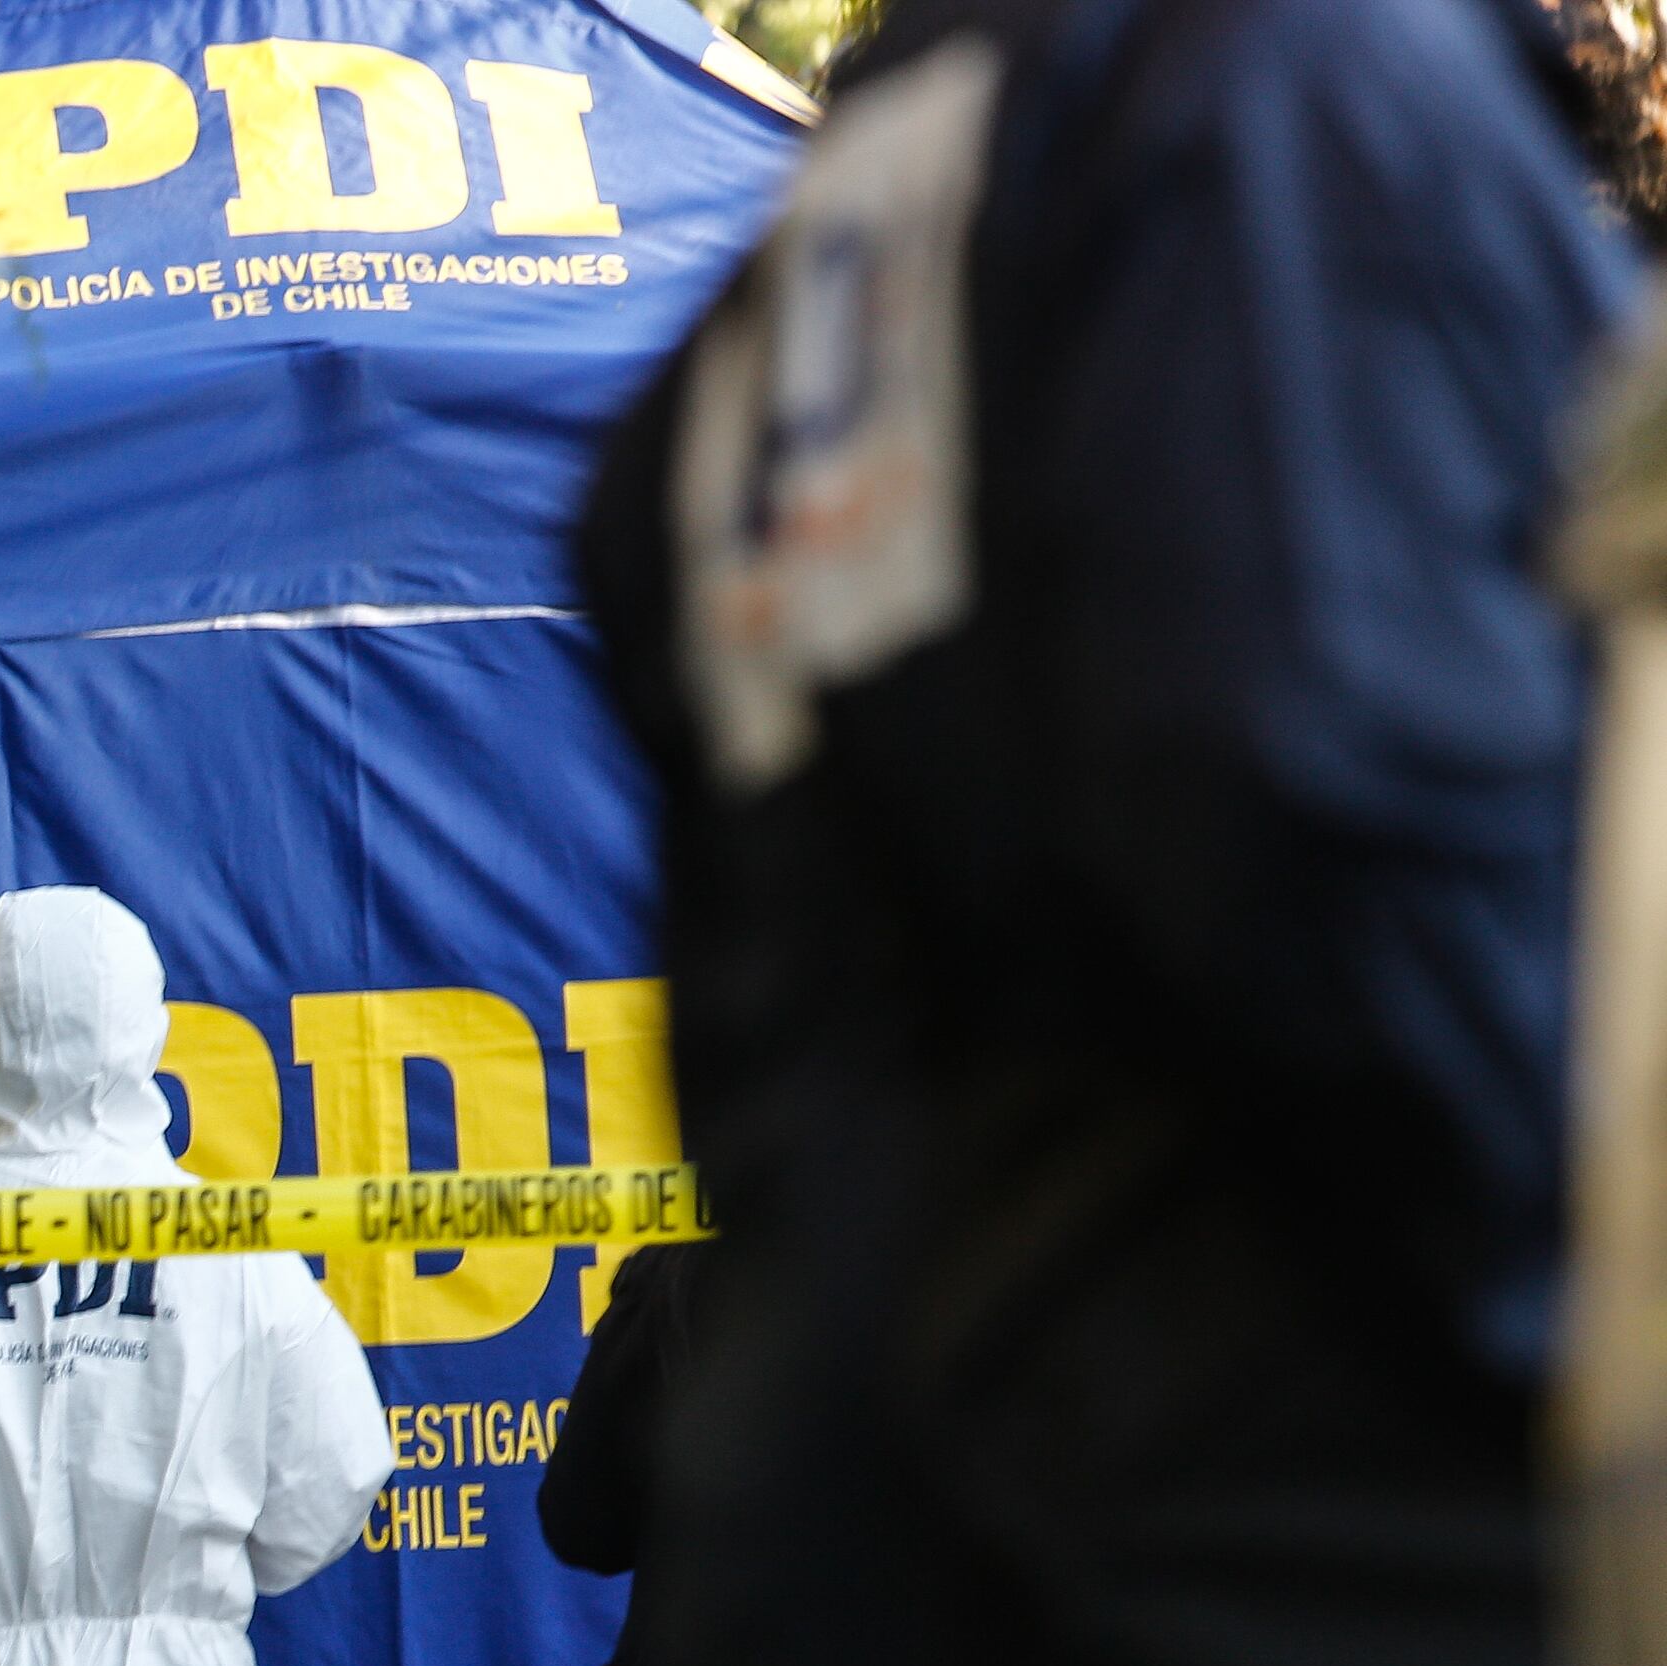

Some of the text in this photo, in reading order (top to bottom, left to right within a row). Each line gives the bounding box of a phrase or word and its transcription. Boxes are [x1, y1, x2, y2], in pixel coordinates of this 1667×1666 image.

[163, 259, 226, 297] DE
[234, 250, 629, 290] INVESTIGACIONES
[211, 282, 413, 321] DE CHILE
[85, 1189, 131, 1254] NO
[147, 1186, 270, 1250] PASAR
[358, 1173, 612, 1242] CARABINEROS
[631, 1169, 679, 1233] DE
[362, 1482, 488, 1553] CHILE
